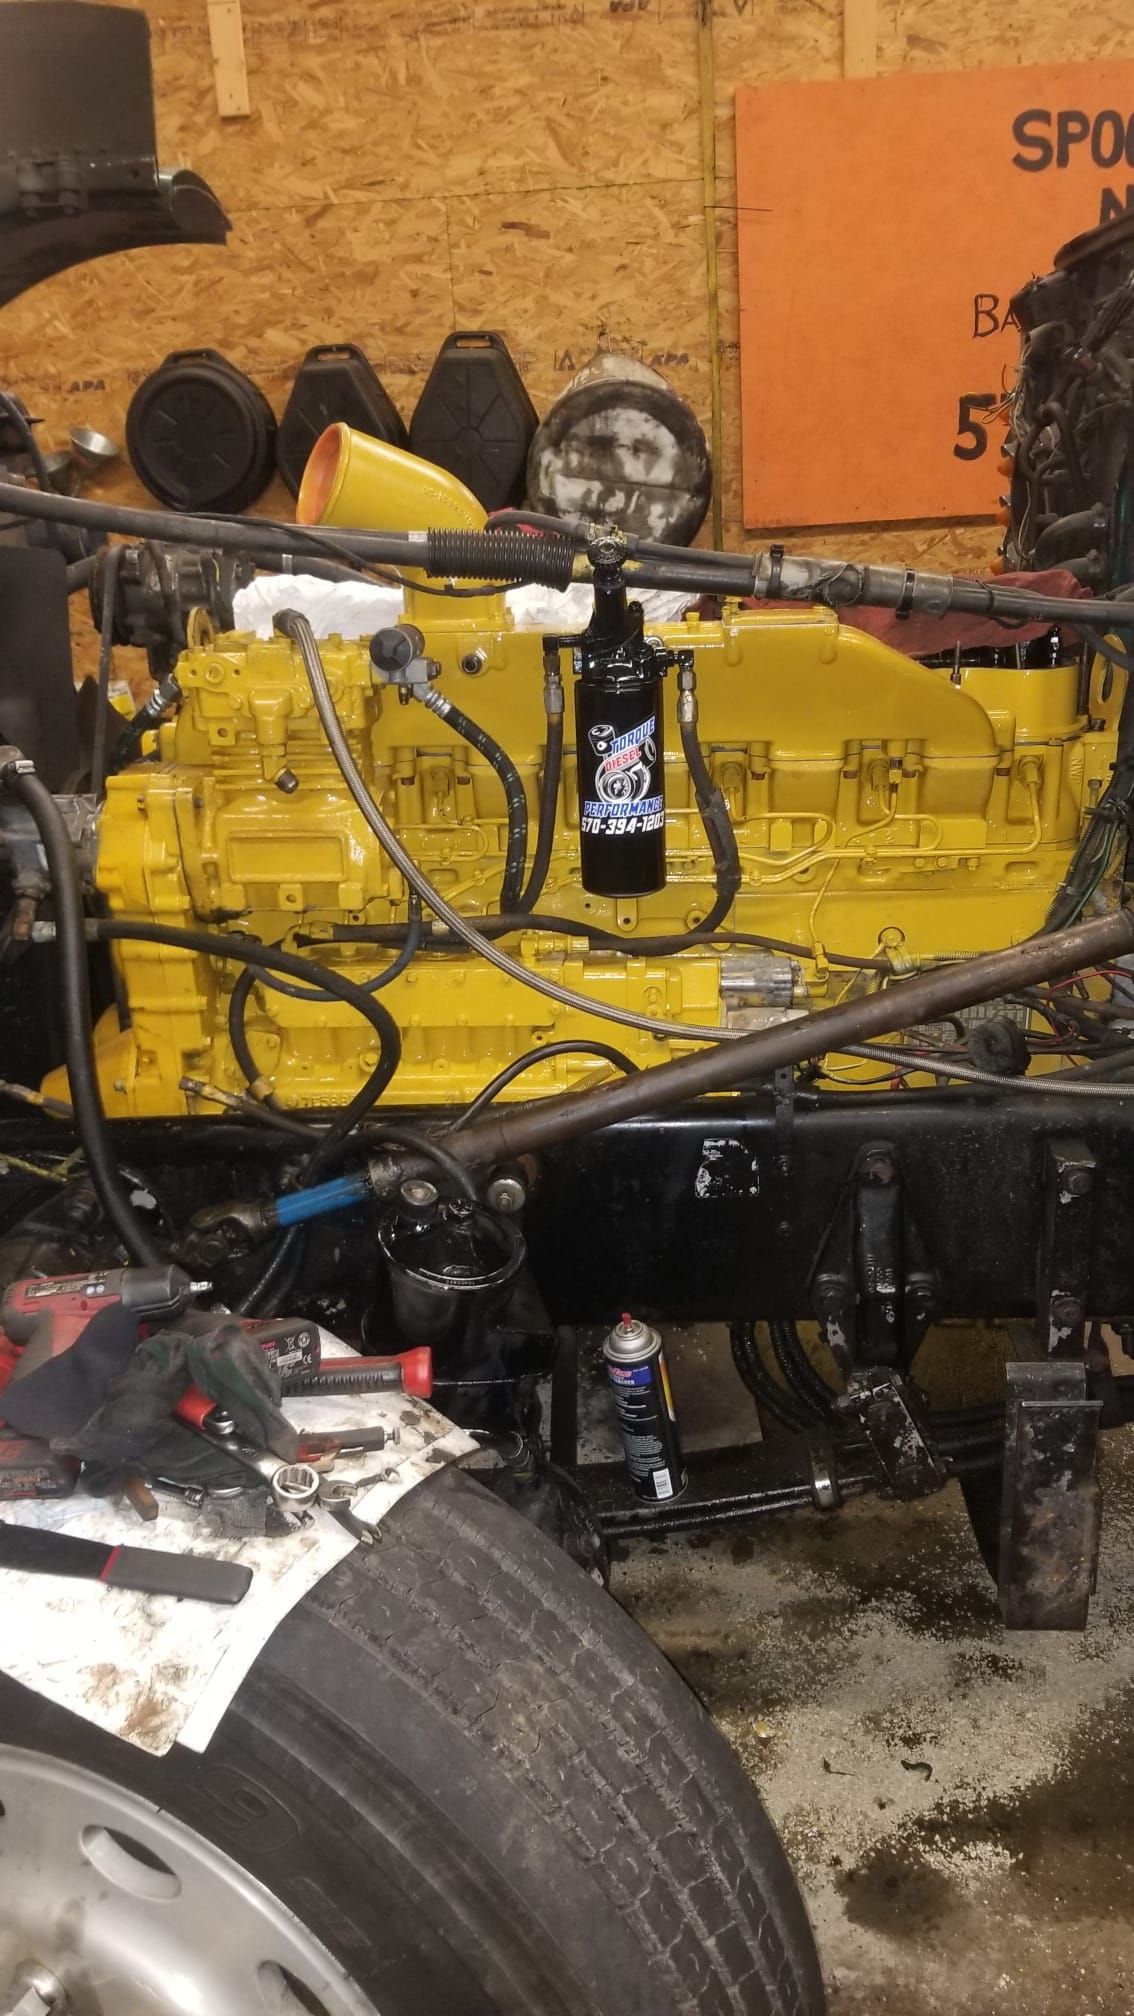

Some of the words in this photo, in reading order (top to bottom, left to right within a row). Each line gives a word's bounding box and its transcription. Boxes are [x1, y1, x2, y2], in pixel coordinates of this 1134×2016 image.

[1012, 108, 1134, 172] SPO
[69, 379, 107, 393] APA
[610, 715, 655, 754] TORQUE
[604, 746, 643, 774] DIESEL
[584, 795, 664, 818] PERFORMANCE
[581, 811, 665, 835] 570-394-1203
